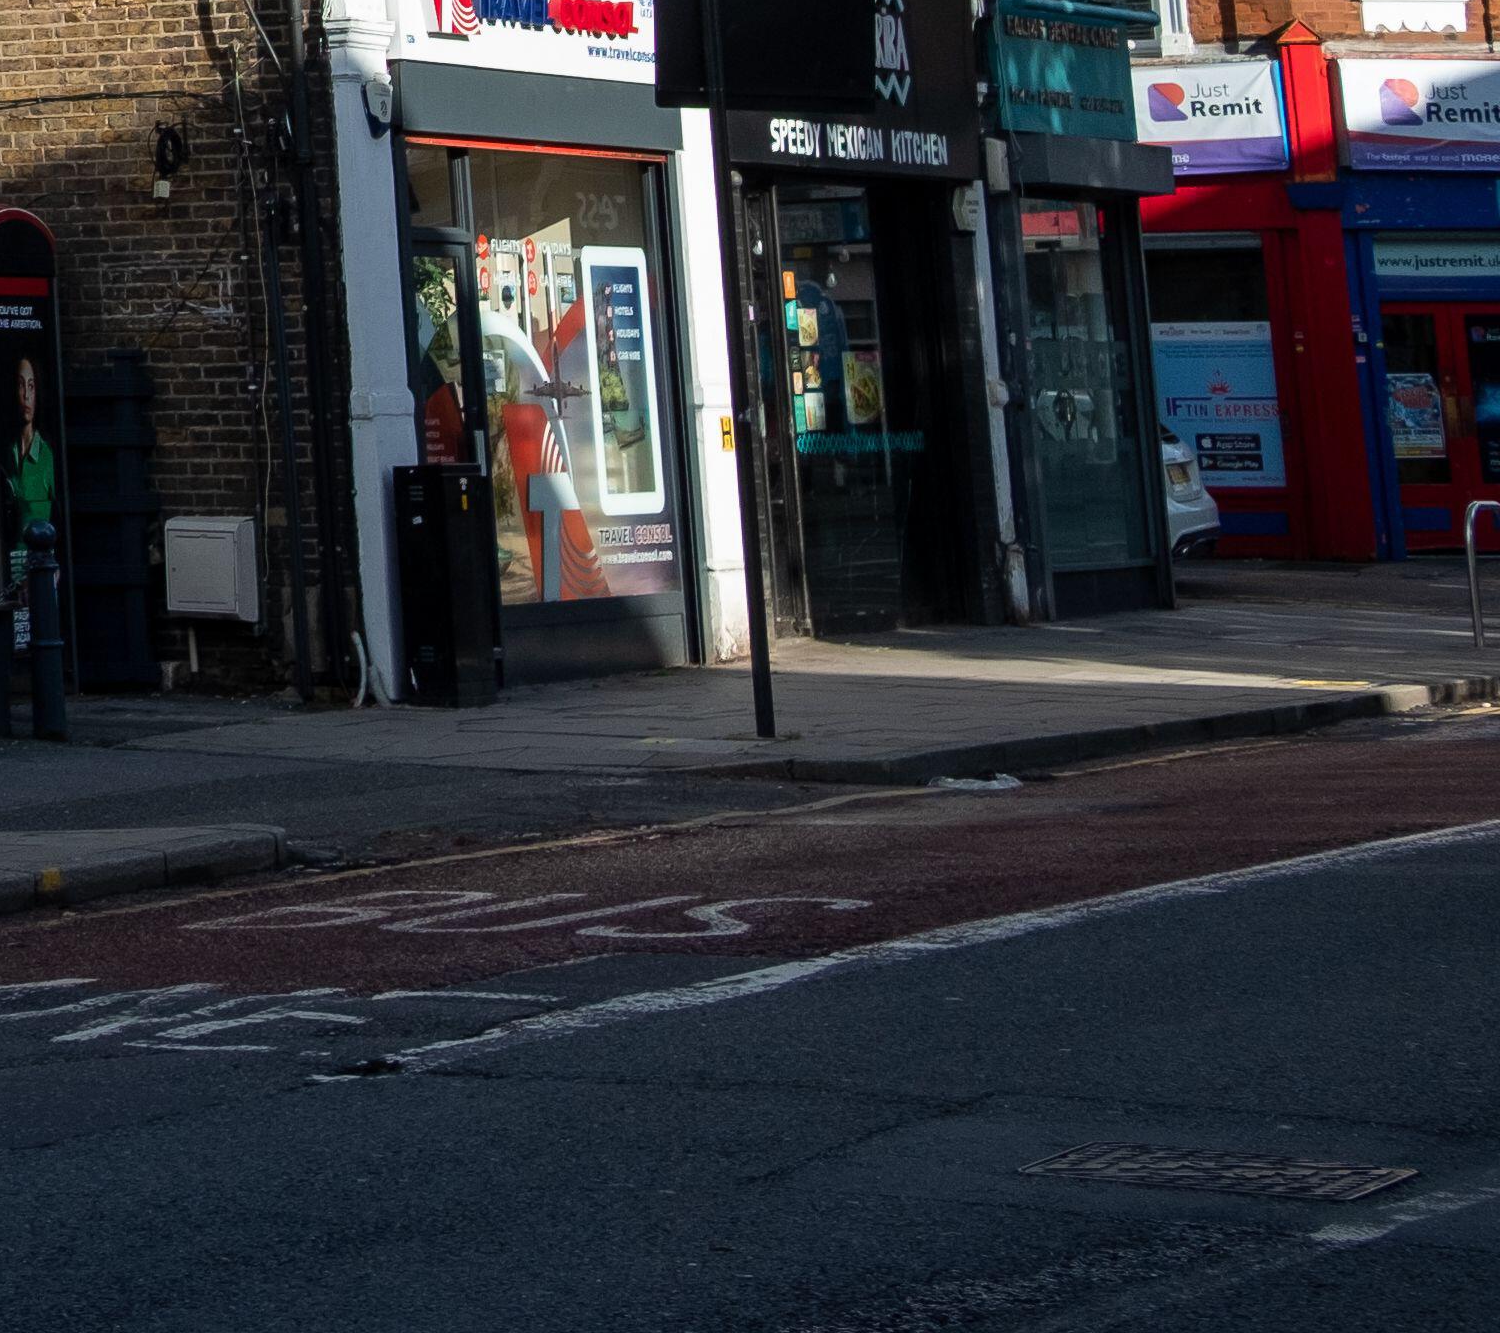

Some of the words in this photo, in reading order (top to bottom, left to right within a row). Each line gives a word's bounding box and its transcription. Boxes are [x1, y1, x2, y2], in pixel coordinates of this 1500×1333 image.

[1190, 82, 1229, 98] Just
[1426, 83, 1468, 100] Just
[1190, 97, 1263, 117] Remit
[1426, 101, 1500, 123] Remit
[770, 118, 821, 158] SPEEDY
[826, 122, 884, 160] MEXICAN
[891, 129, 948, 165] KITCHEN
[490, 238, 520, 253] FLIGHTS
[612, 284, 633, 294] FLIGHTS
[615, 306, 634, 317] HOTELS
[1215, 404, 1280, 416] EXPRESS
[597, 526, 634, 546] TRAVEL
[635, 524, 673, 545] CONSOL
[181, 889, 873, 938] BUS
